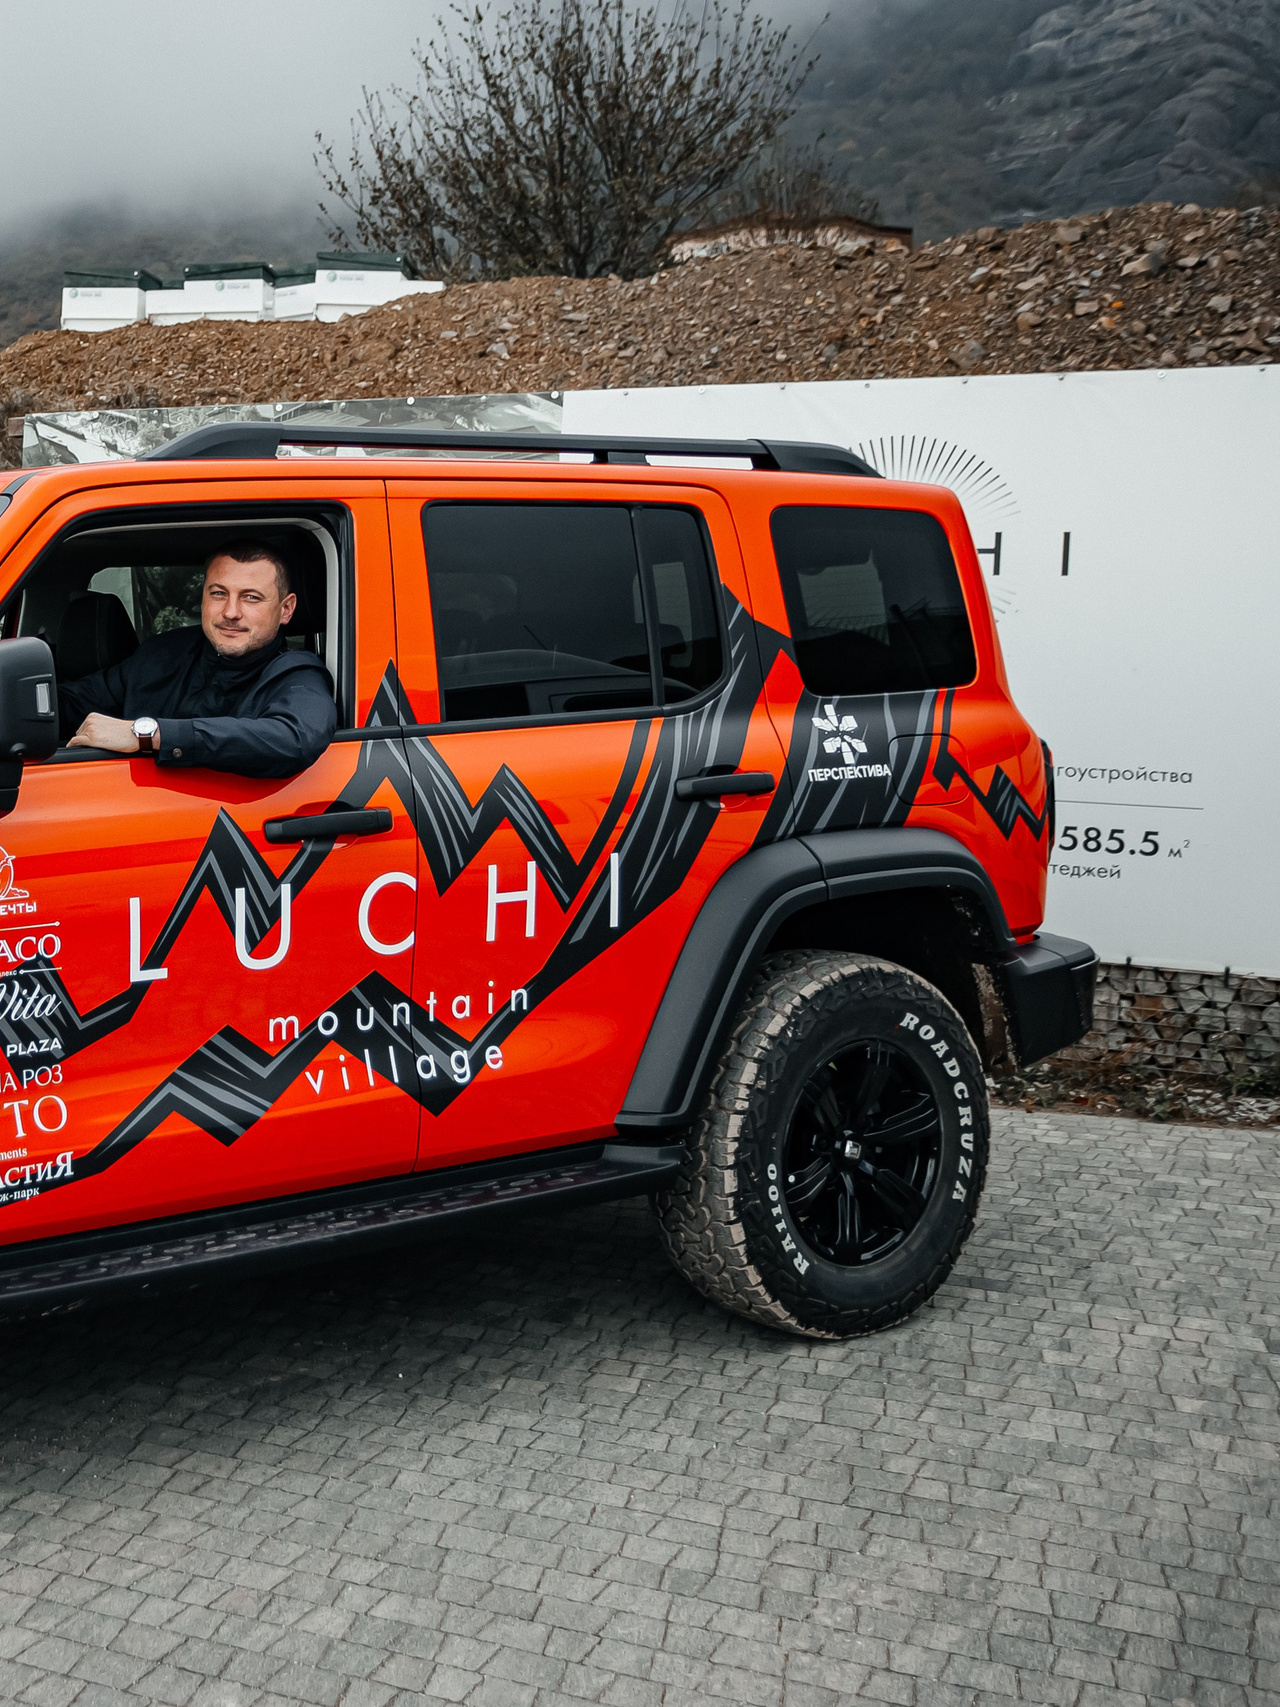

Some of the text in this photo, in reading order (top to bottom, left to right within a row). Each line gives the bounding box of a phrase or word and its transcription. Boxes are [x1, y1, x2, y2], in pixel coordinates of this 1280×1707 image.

[808, 764, 892, 782] ПЕРСПЕКТИВА
[1056, 766, 1193, 784] гоустройства
[1049, 864, 1121, 879] теджей
[129, 852, 620, 983] LUCHI
[268, 980, 528, 1043] mountain
[6, 1037, 62, 1058] PLAZA
[22, 1064, 63, 1089] РОЗ
[305, 1044, 504, 1095] village
[899, 1012, 974, 1203] ROADCRUZA
